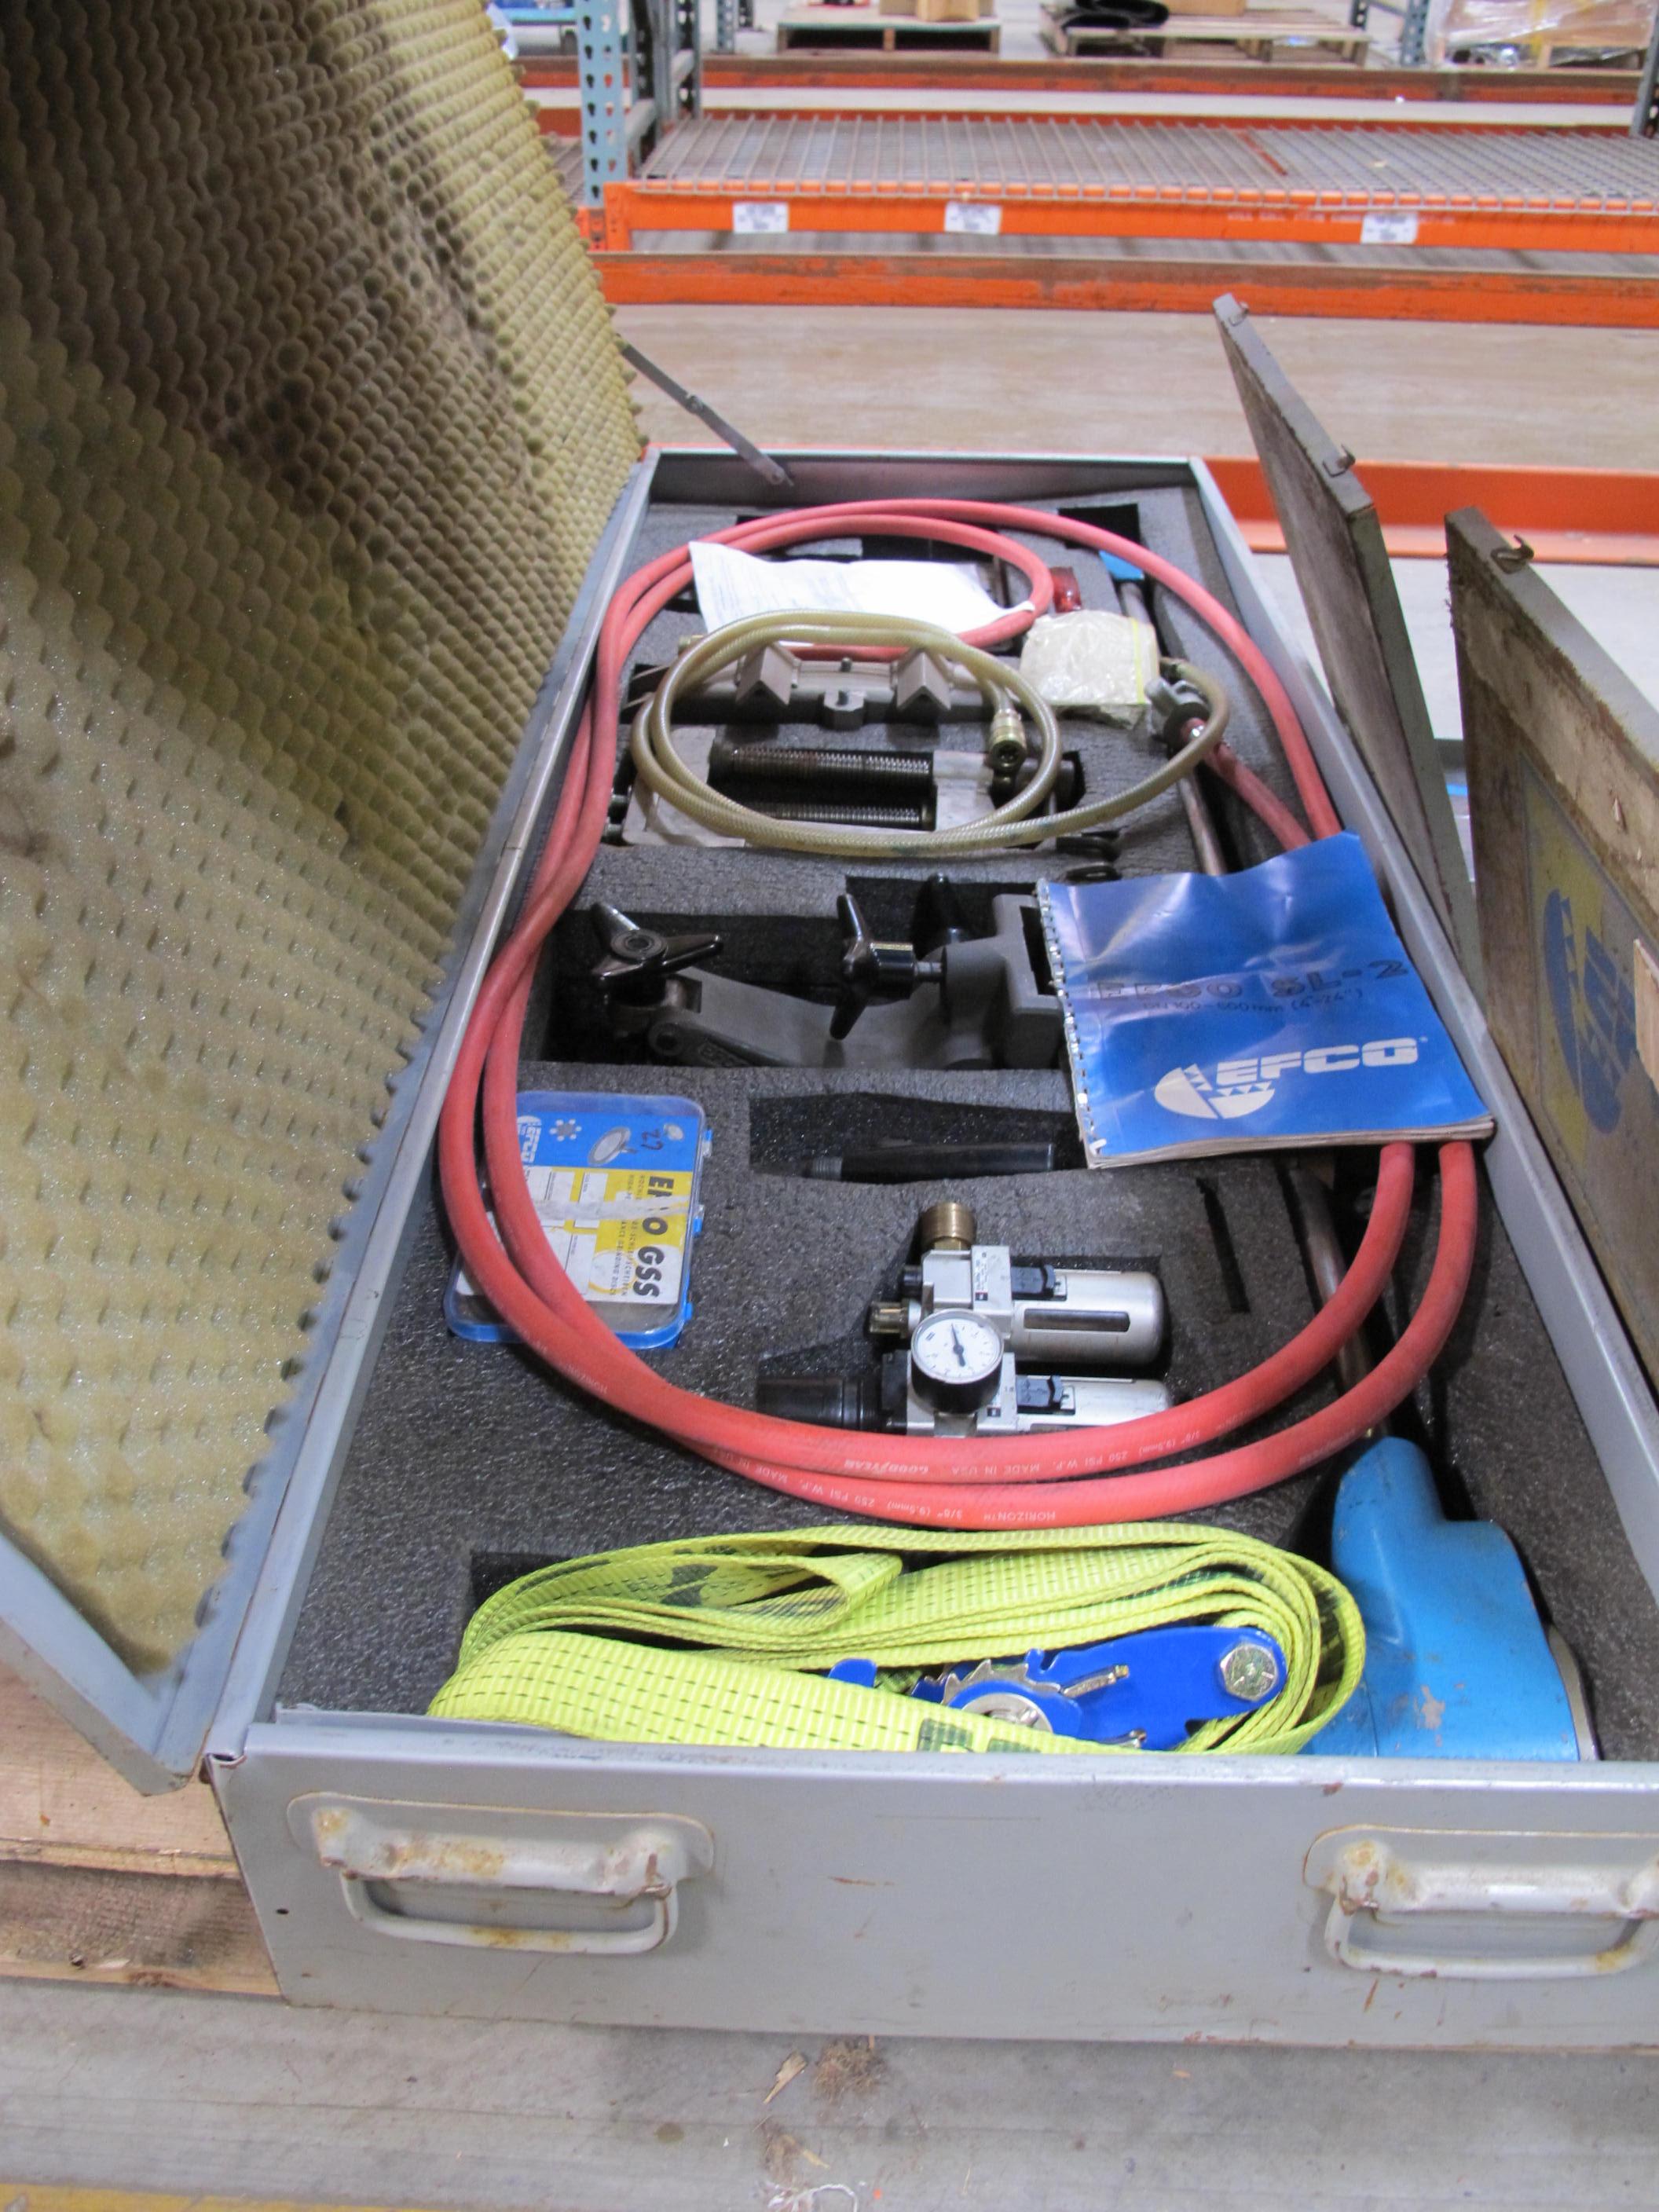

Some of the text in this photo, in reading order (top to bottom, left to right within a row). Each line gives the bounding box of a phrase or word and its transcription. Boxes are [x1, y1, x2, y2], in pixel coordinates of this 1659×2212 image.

[1096, 959, 1409, 1001] EFCO SL-2
[1215, 1037, 1419, 1085] EFCO
[632, 1176, 675, 1298] EFO GSS
[1085, 1456, 1104, 1467] PSI
[1108, 1450, 1129, 1462] 250
[844, 1458, 929, 1474] GOODYEAR
[950, 1464, 978, 1476] USA
[983, 1465, 998, 1475] IN
[1004, 1463, 1041, 1475] MADE
[755, 1464, 789, 1484] MADE
[829, 1489, 849, 1501] PSI
[854, 1495, 876, 1507] 250
[886, 1500, 931, 1517] (9.5mm)
